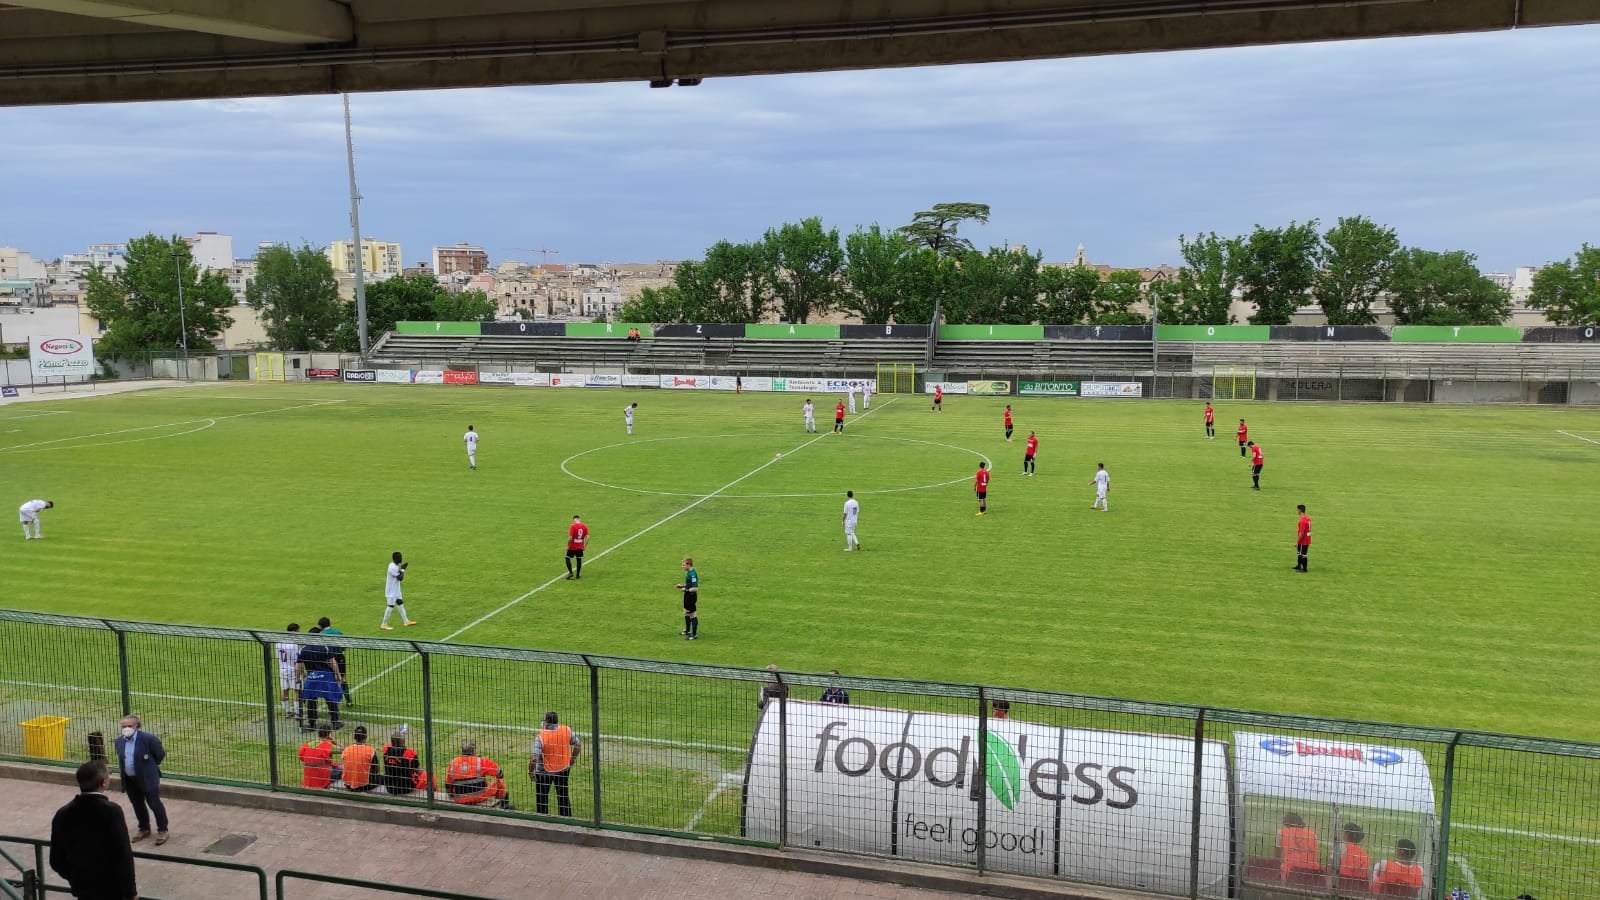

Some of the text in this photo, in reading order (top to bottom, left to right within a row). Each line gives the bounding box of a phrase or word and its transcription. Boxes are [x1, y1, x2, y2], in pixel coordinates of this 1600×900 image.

[577, 528, 583, 539] 9
[905, 813, 1044, 856] feel good!
